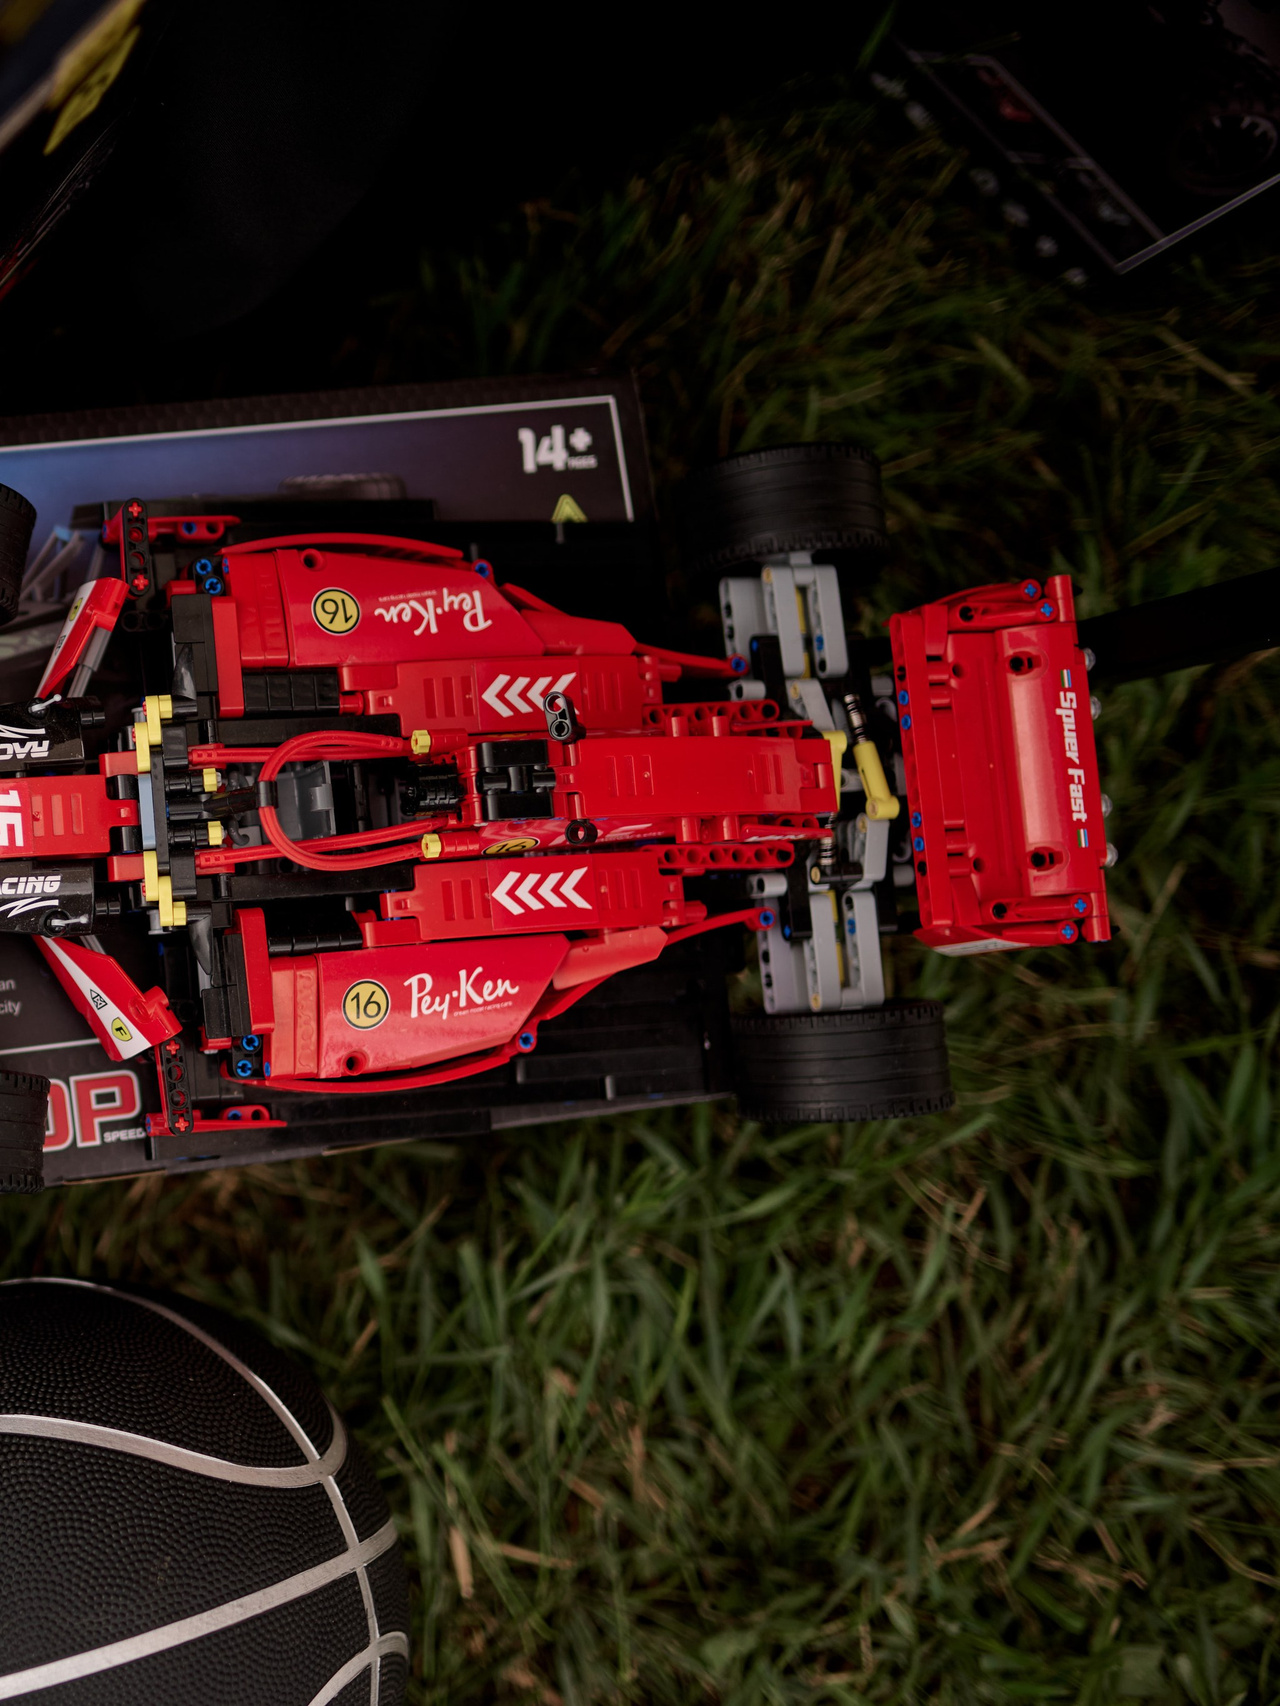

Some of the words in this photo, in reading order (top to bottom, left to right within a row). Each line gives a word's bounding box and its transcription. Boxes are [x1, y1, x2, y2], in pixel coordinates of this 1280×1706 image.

[320, 598, 353, 624] 16
[1055, 690, 1080, 765] Spuer
[1067, 767, 1088, 823] Fast
[351, 990, 382, 1019] 16
